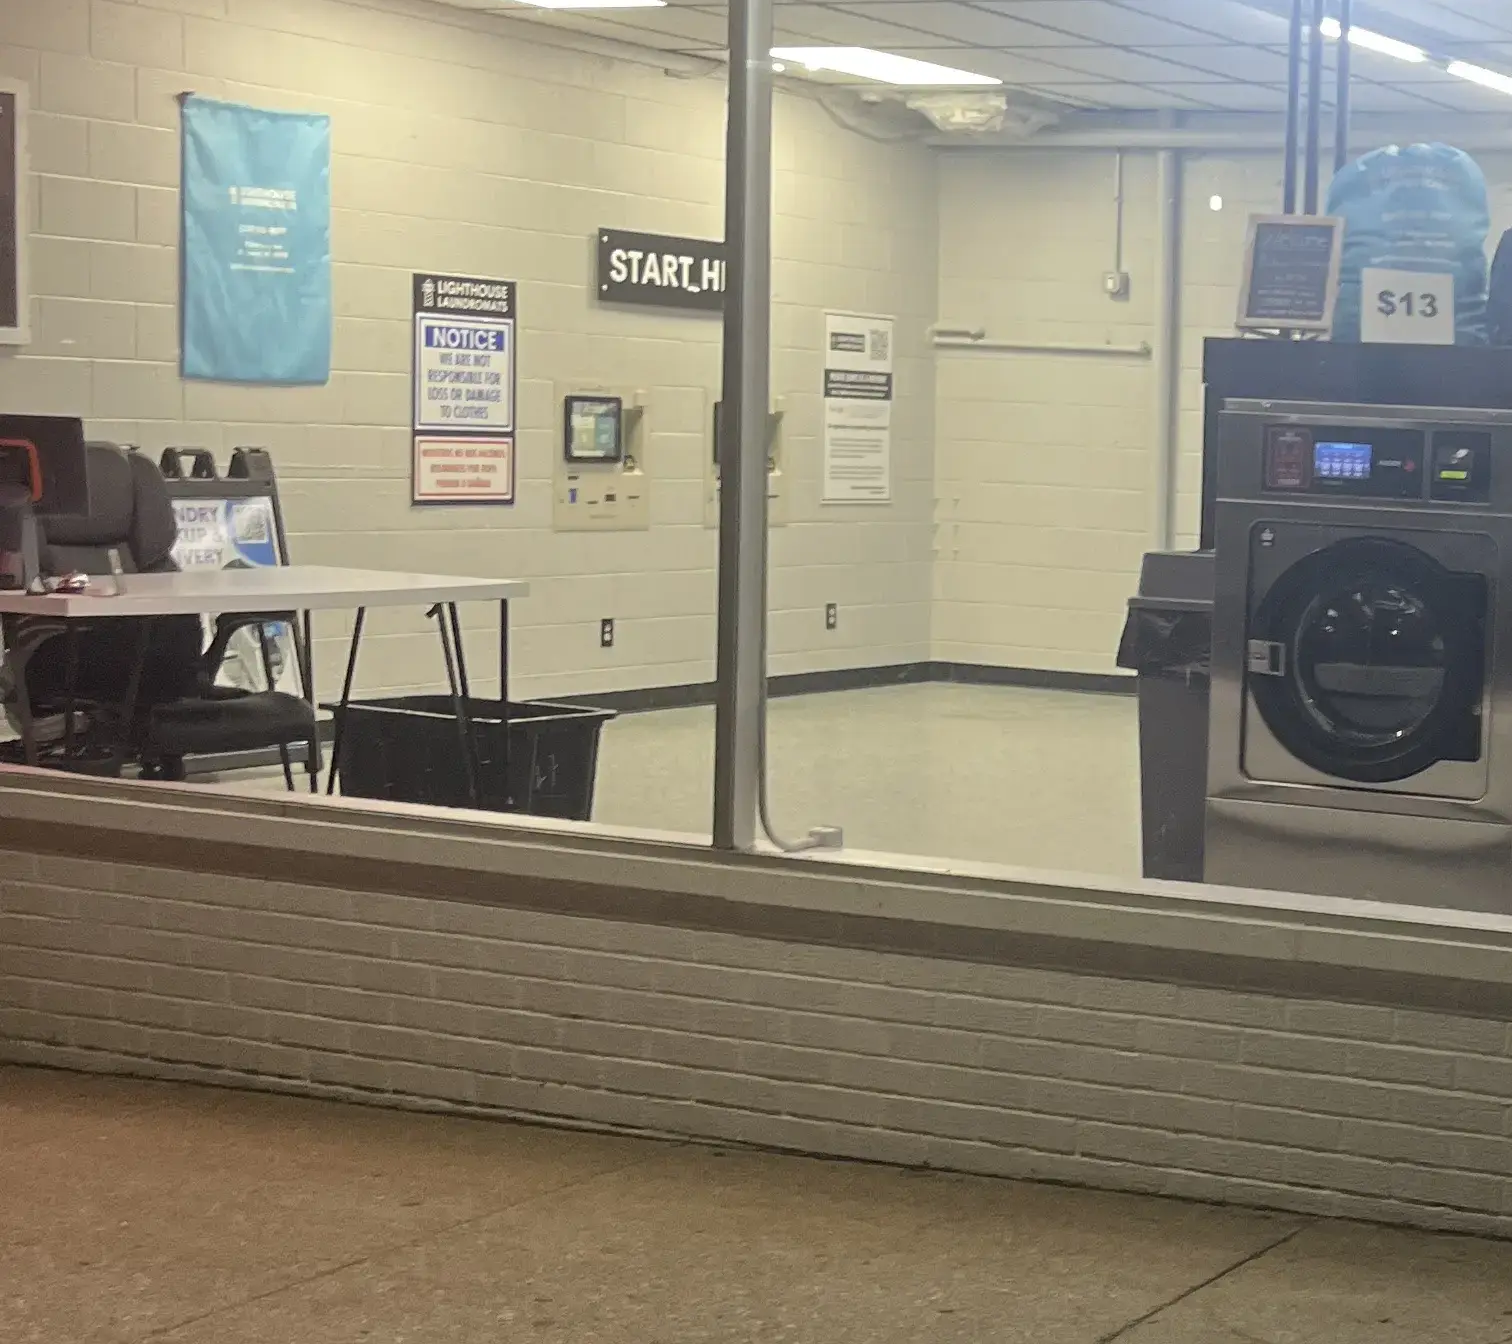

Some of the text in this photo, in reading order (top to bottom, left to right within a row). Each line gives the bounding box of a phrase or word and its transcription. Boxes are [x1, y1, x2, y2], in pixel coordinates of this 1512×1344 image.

[609, 248, 726, 293] START_H
[436, 280, 509, 299] LIGHTHOUSE
[436, 295, 509, 313] LAUNDROMATS
[1377, 289, 1439, 318] $13
[432, 327, 498, 350] NOTICE
